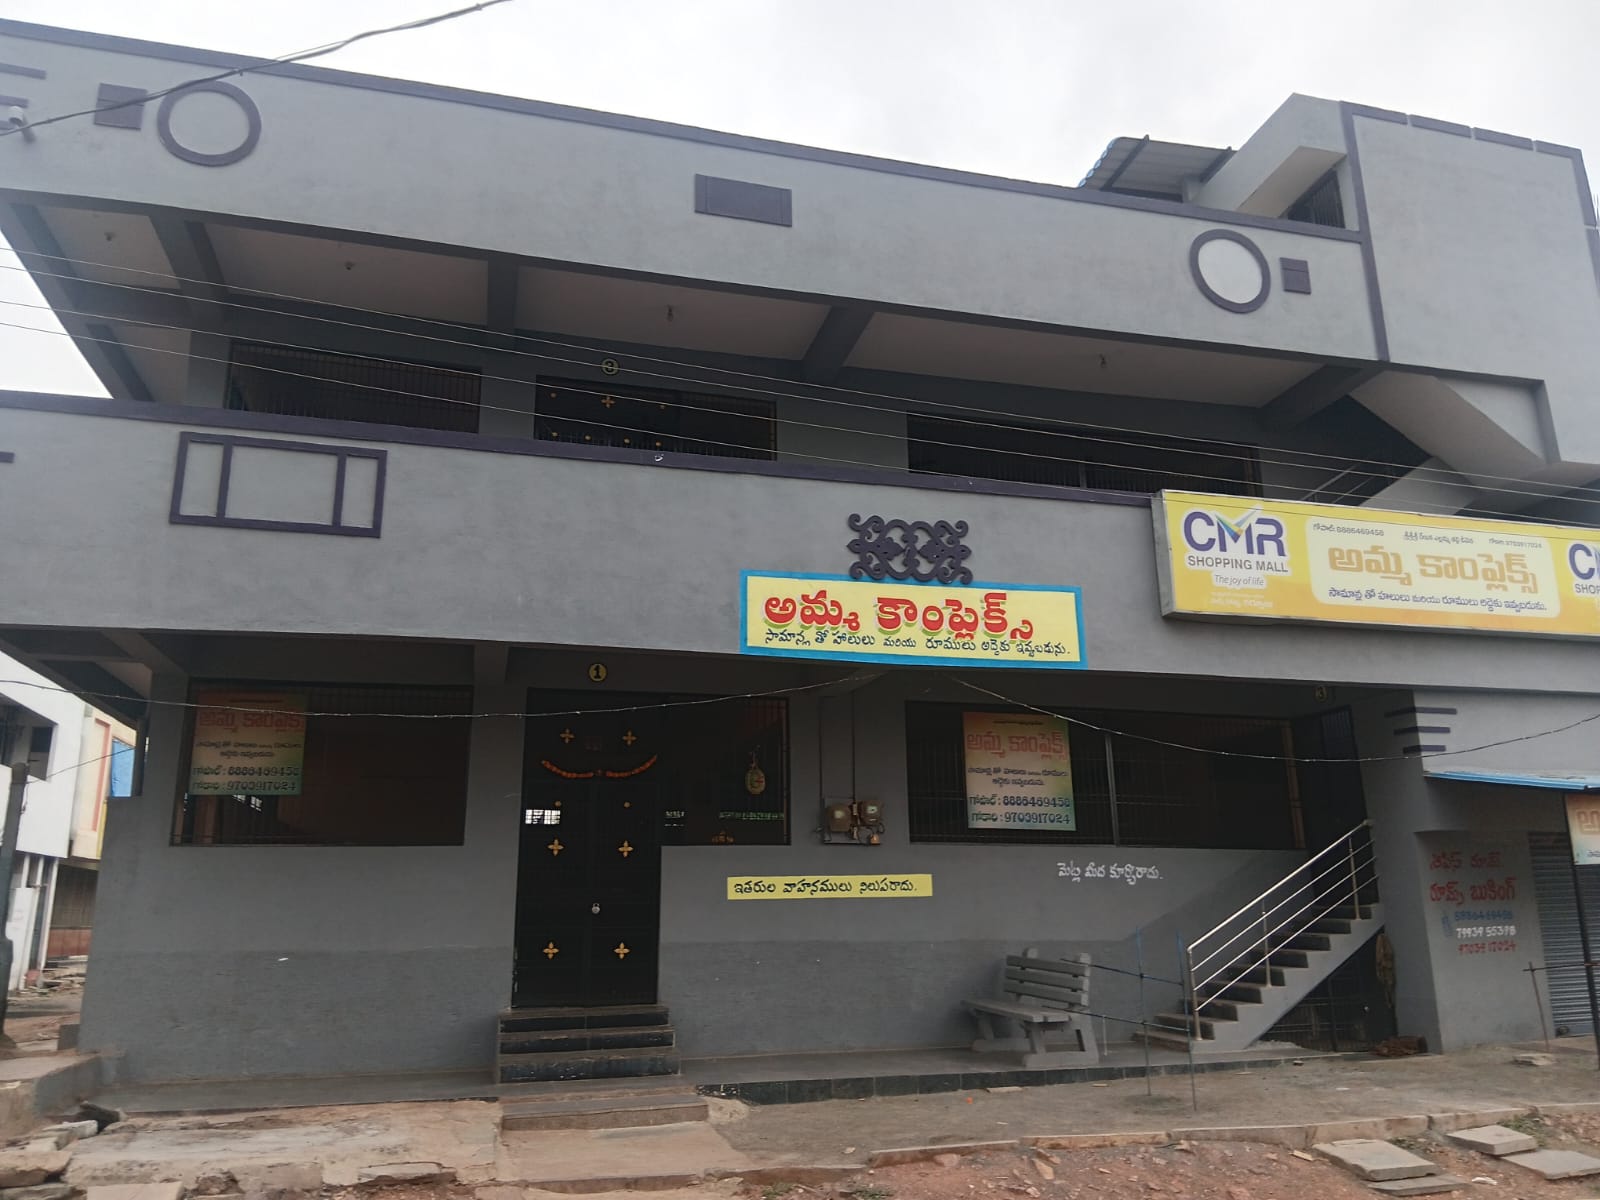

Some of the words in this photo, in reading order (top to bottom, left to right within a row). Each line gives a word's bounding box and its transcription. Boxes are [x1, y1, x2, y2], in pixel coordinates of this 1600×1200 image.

[1183, 503, 1286, 557] CMR
[1187, 554, 1252, 572] SHOPPING
[1255, 559, 1289, 574] MALL
[1328, 545, 1413, 586] అమ్మ
[1416, 551, 1538, 594] కాంప్లెక్స్
[1229, 576, 1242, 586] joy
[1252, 577, 1265, 587] life
[763, 590, 861, 632] అమ్మ
[876, 592, 1035, 641] కాంప్లెక్స్
[815, 629, 829, 644] తో
[883, 636, 917, 649] మరియు
[925, 637, 977, 651] రూములు
[1004, 812, 1071, 825] 9703917024
[733, 880, 776, 895] ఇతరుల
[782, 879, 853, 896] వాహనములు
